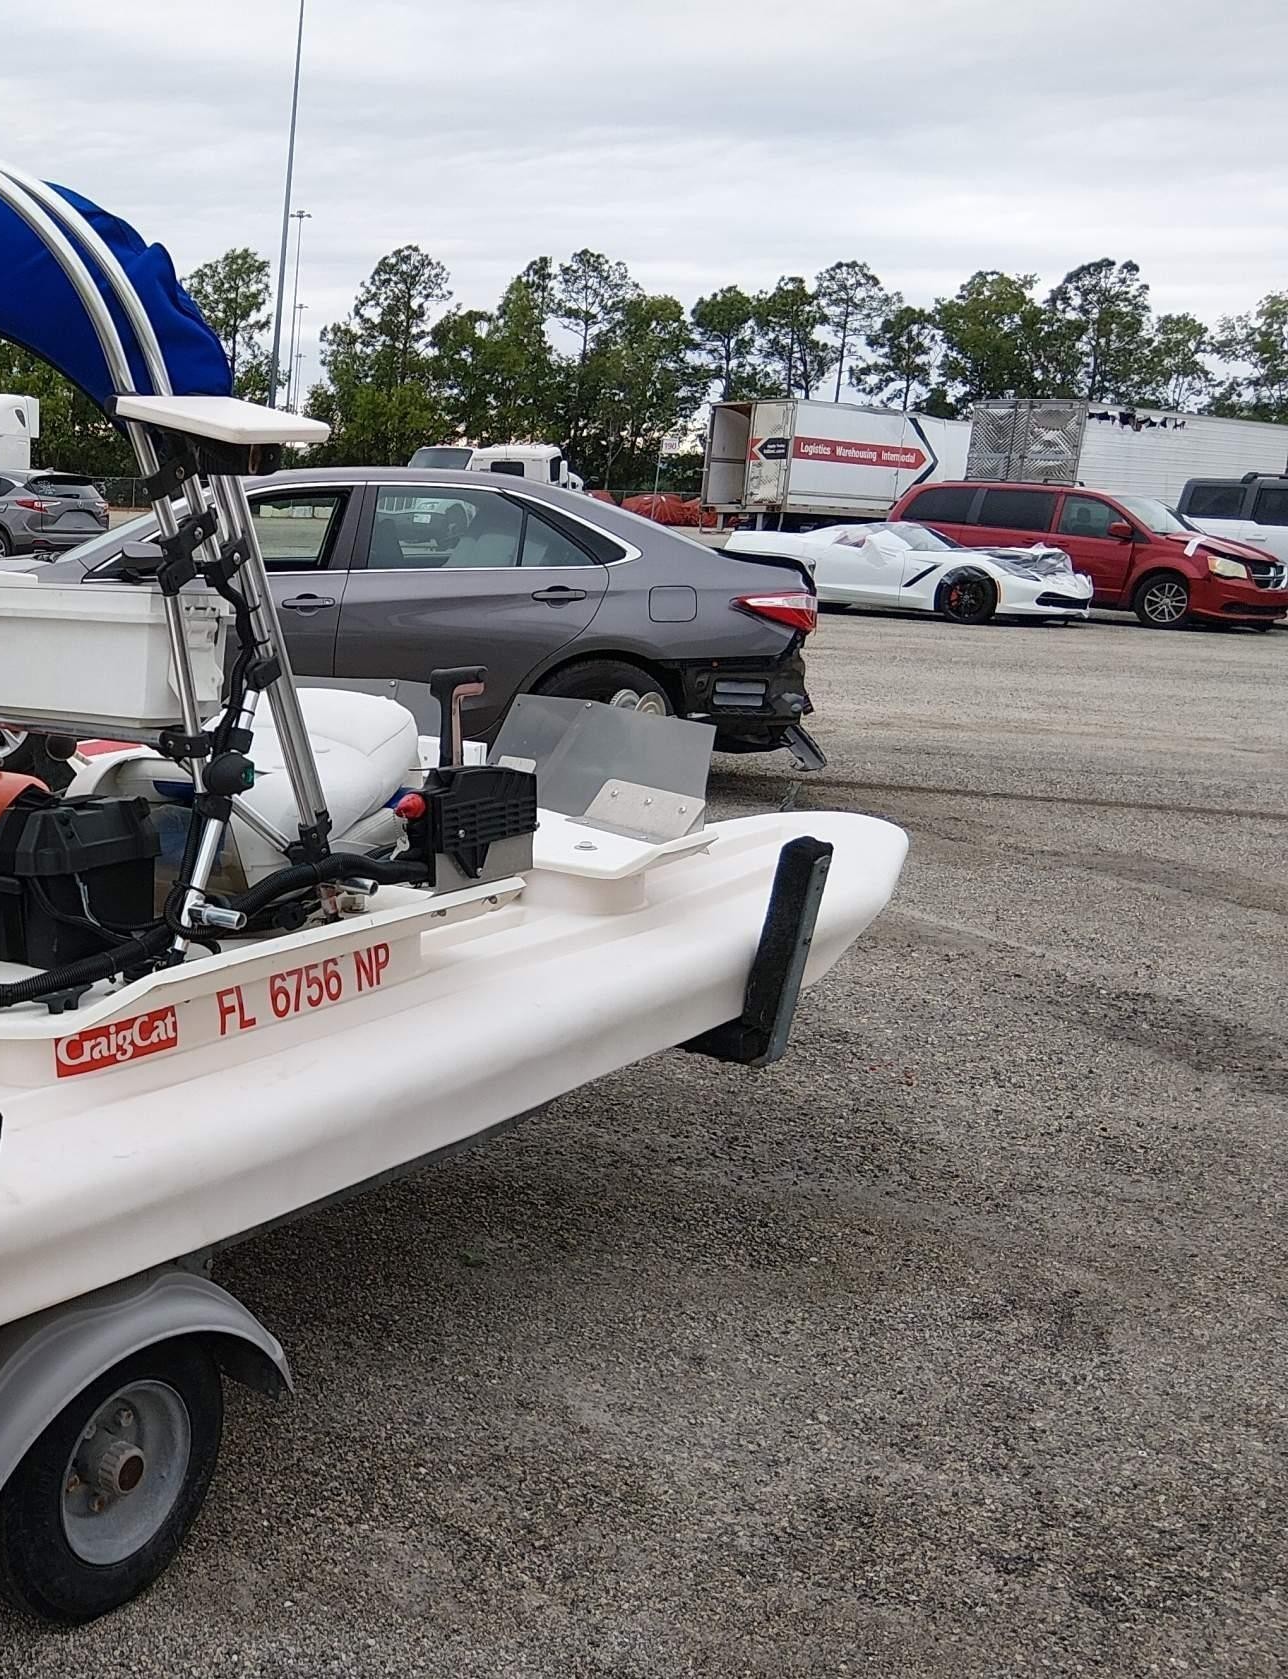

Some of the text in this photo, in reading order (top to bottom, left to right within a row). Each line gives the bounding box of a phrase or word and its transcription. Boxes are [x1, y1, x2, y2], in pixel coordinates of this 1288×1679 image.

[800, 441, 831, 456] Logistics
[836, 445, 878, 462] Warehousing
[216, 943, 390, 1036] FL 6756 NP
[57, 1010, 177, 1066] CraigCat
